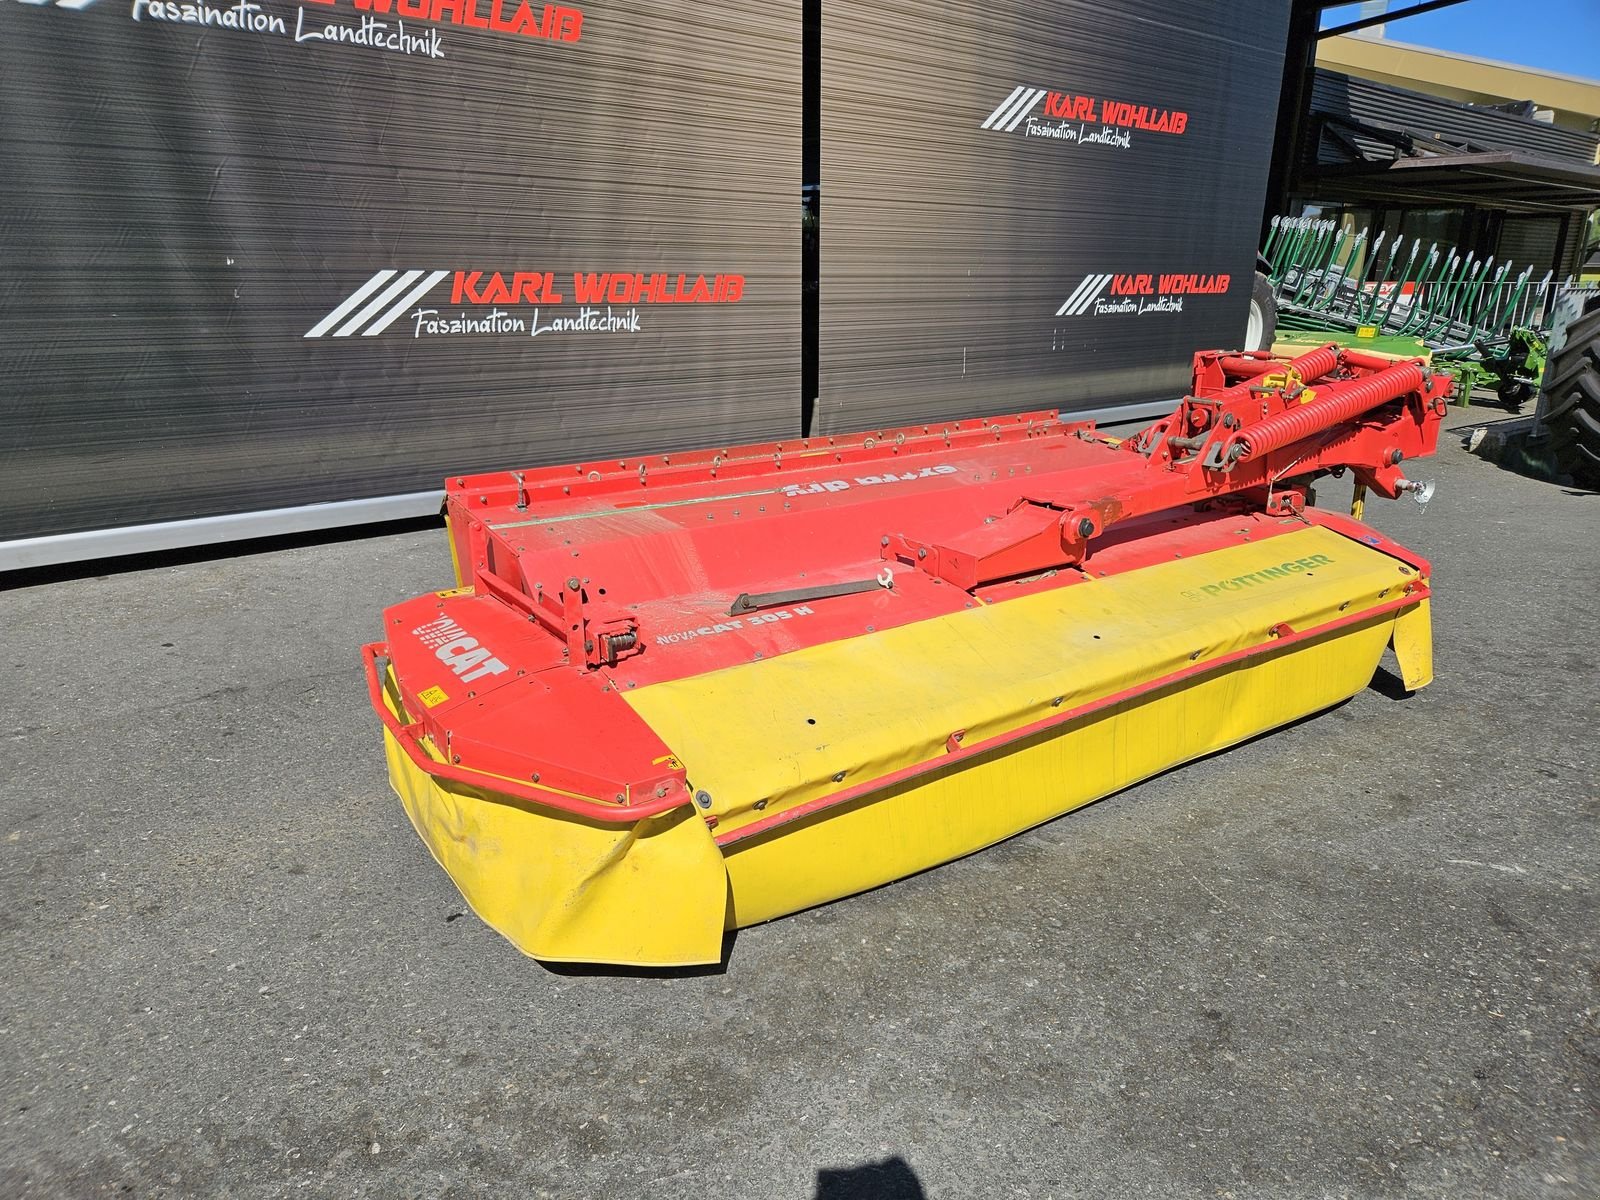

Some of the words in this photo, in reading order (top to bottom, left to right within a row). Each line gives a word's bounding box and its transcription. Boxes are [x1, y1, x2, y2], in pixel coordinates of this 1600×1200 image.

[295, 7, 445, 58] Landtechnik
[1043, 92, 1097, 122] KARL
[1024, 115, 1077, 140] Faszination
[1077, 124, 1131, 149] Landtechnik
[450, 271, 563, 304] KARL
[1110, 274, 1154, 295] KARL
[1093, 296, 1137, 316] Faszination
[1137, 295, 1183, 316] Landtechnik
[411, 308, 525, 338] Faszination
[531, 306, 641, 337] Landtechnik
[656, 620, 744, 646] NOVACAT
[747, 610, 793, 627] 305
[793, 605, 815, 616] H
